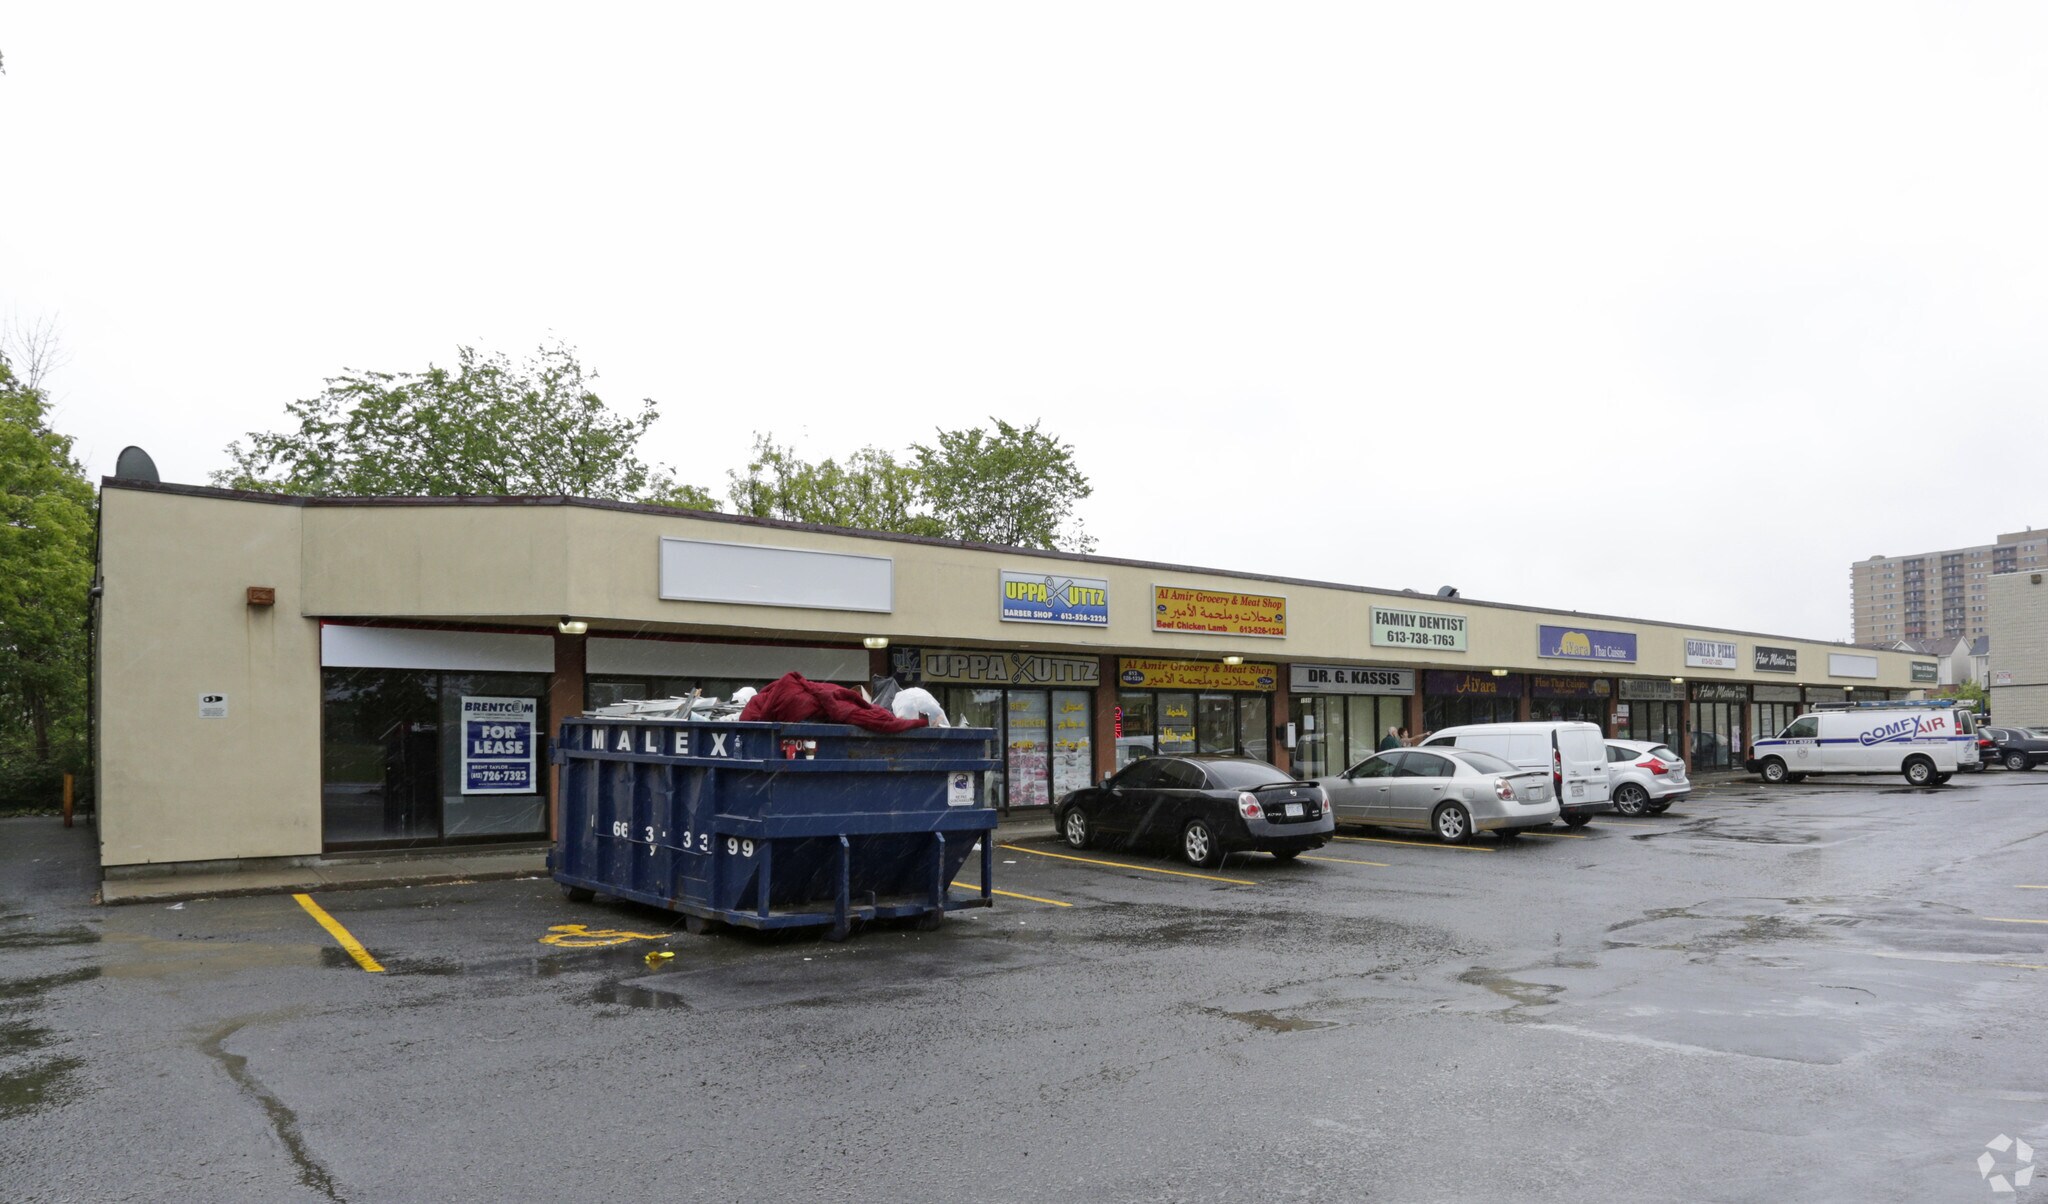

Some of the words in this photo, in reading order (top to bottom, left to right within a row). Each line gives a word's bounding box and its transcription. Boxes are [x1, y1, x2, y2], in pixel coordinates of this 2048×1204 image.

[1005, 581, 1047, 603] UPPA
[1158, 589, 1168, 599] Al
[1171, 591, 1194, 601] Amir
[1196, 593, 1229, 606] Grocery
[1231, 596, 1238, 605] &
[1240, 596, 1261, 607] Meat
[1262, 598, 1282, 610] Shop
[1004, 609, 1032, 618] BARBER
[1033, 610, 1053, 619] SHOP
[1060, 612, 1107, 622] 613-526-2226
[1376, 611, 1416, 627] FAMILY
[1419, 615, 1464, 631] DENTIST
[1156, 620, 1174, 628] Beef
[1176, 621, 1206, 631] Chicken
[1207, 623, 1227, 632] Lamb
[1387, 631, 1455, 646] 613-738-1763
[1594, 645, 1606, 657] Thai
[1607, 646, 1626, 658] Cuisine
[1688, 641, 1715, 657] GLORIA'S
[1717, 644, 1736, 659] PIZZA
[1756, 652, 1769, 664] Hair
[1769, 653, 1786, 665] Motion
[926, 655, 1008, 681] UPPA
[1124, 660, 1137, 669] Al
[1140, 661, 1167, 670] Amir
[1170, 662, 1210, 674] Grocery
[1212, 664, 1220, 673] &
[1223, 664, 1248, 674] Meat
[1249, 665, 1272, 676] Shop
[1308, 669, 1332, 683] DR.
[1335, 670, 1348, 683] G.
[1351, 671, 1400, 685] KASSIS
[1699, 685, 1715, 698] Hair
[1715, 685, 1736, 698] Motion
[1010, 719, 1046, 728] CHICKEN
[1859, 715, 1922, 746] COMFY
[1918, 717, 1946, 733] AIR
[482, 725, 516, 739] FOR
[474, 741, 524, 754] LEASE
